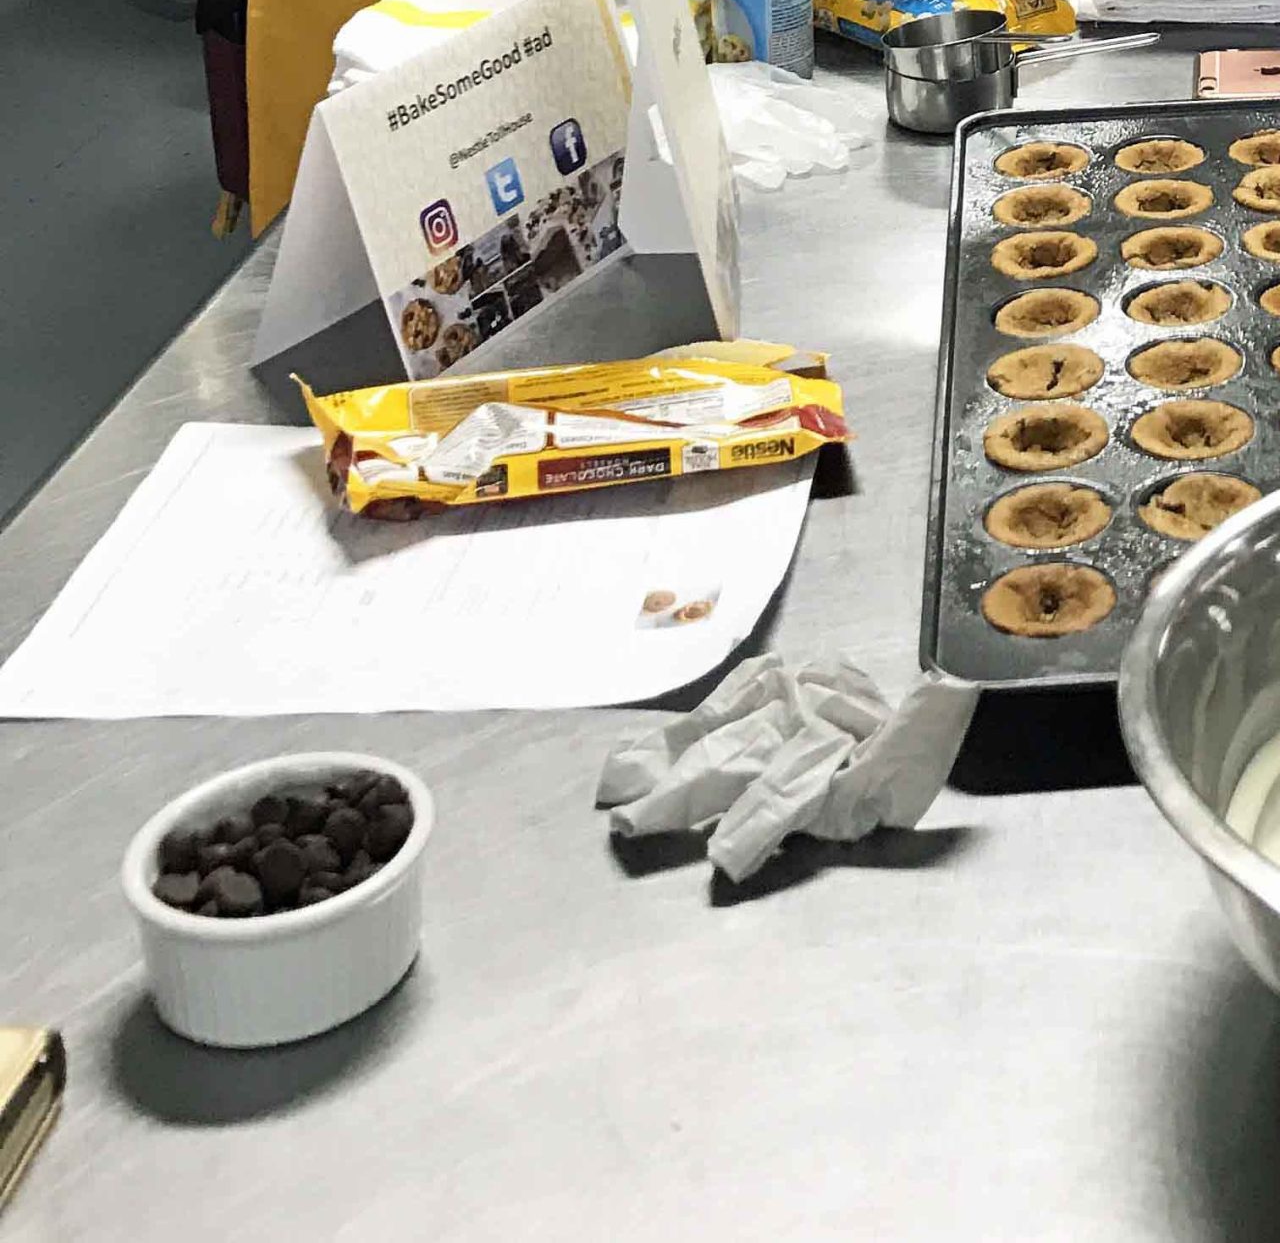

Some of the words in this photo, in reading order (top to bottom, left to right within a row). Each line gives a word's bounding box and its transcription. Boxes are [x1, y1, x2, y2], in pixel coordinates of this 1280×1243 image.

[386, 41, 523, 132] #BakeSomeGood
[523, 25, 553, 58] #ad
[449, 111, 534, 170] @NestleTollHouse
[544, 466, 625, 485] CHOCOLATE
[629, 461, 666, 476] DARK
